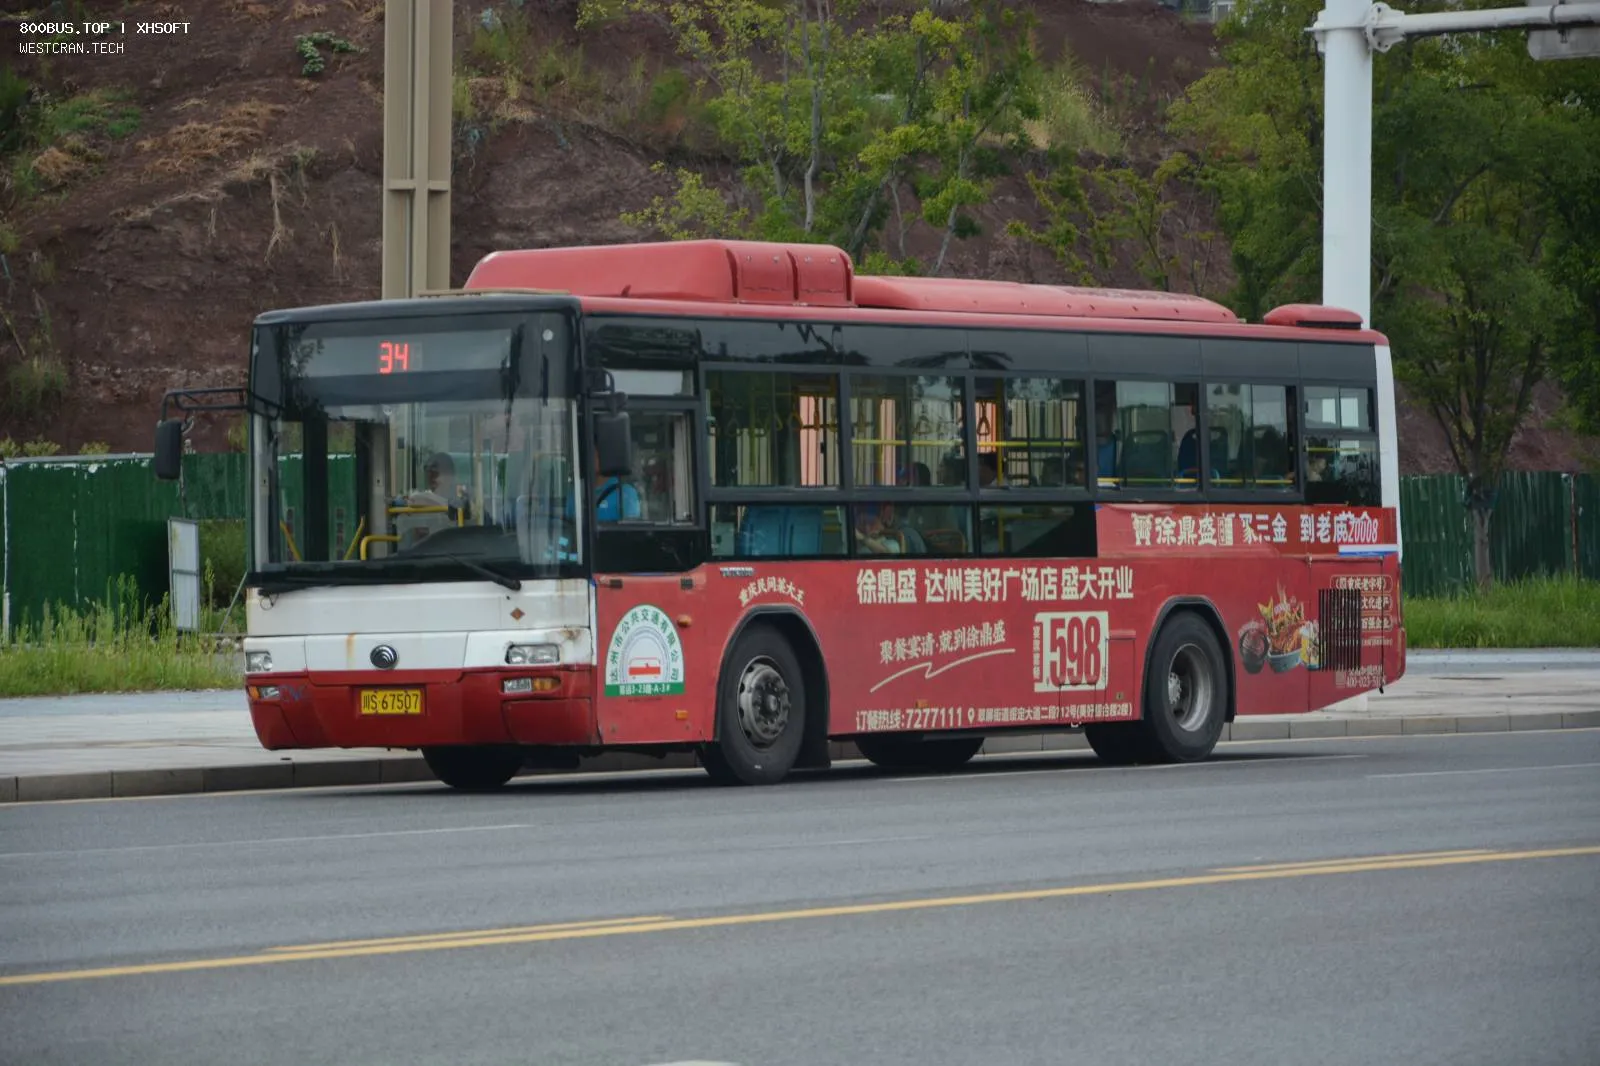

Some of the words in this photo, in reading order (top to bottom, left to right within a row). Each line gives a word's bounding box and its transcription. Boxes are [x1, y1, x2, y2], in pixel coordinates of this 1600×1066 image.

[379, 341, 409, 374] 34
[856, 568, 917, 604] 徐鼎盛
[924, 567, 1058, 602] 达州美好广场店
[1061, 566, 1134, 600] 盛大开业
[1049, 615, 1101, 688] 598
